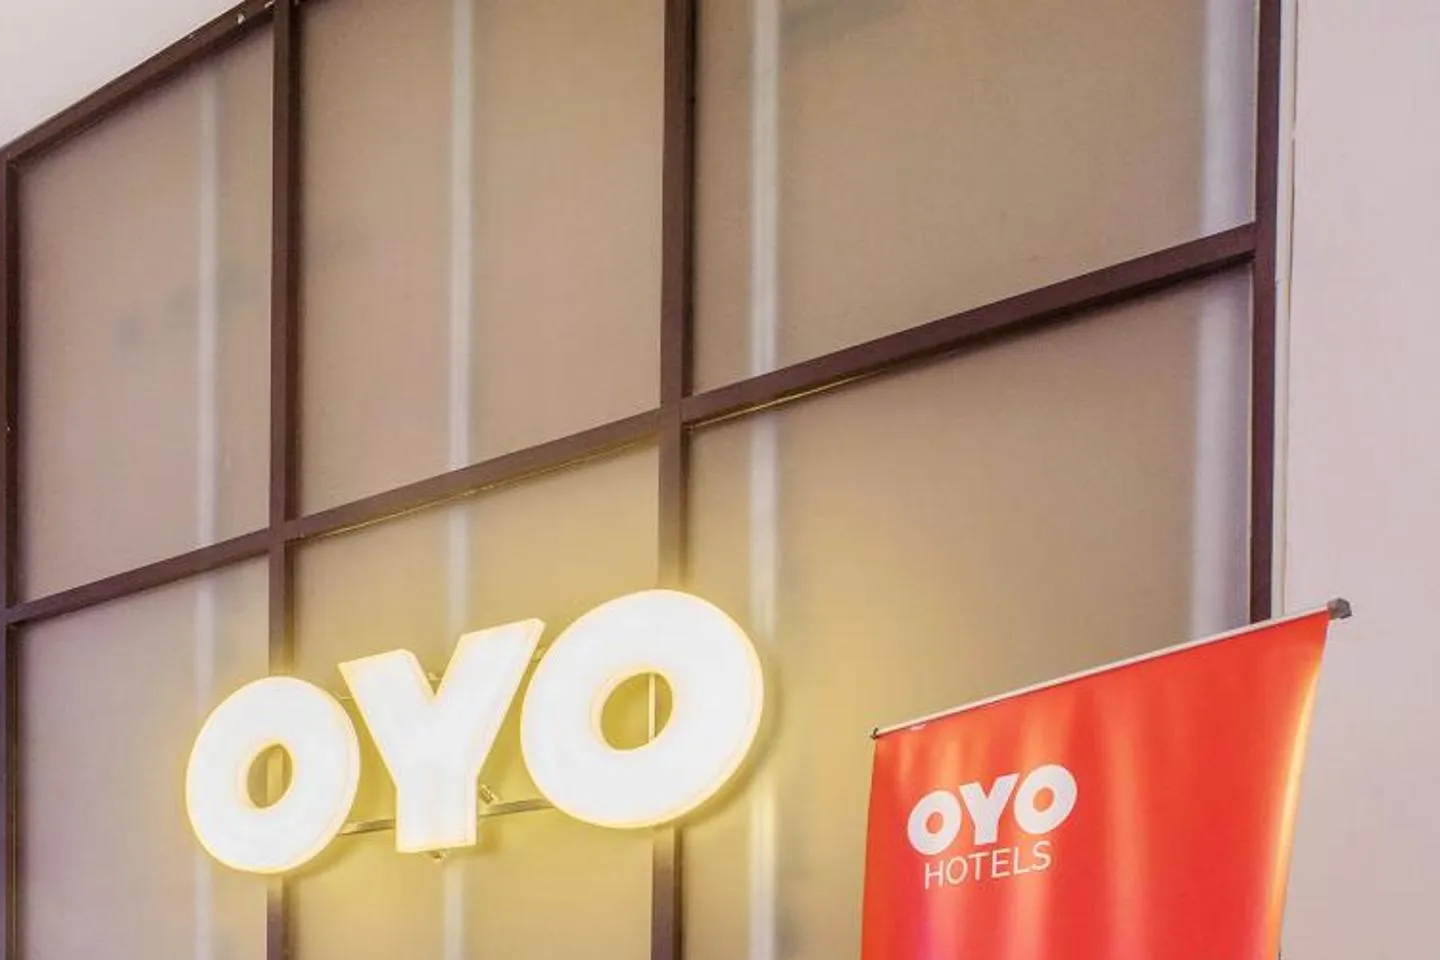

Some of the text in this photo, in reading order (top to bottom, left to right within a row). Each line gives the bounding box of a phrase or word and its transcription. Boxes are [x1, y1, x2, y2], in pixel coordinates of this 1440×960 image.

[186, 589, 764, 874] OYO
[907, 764, 1078, 856] OYO
[923, 840, 1052, 889] HOTELS
